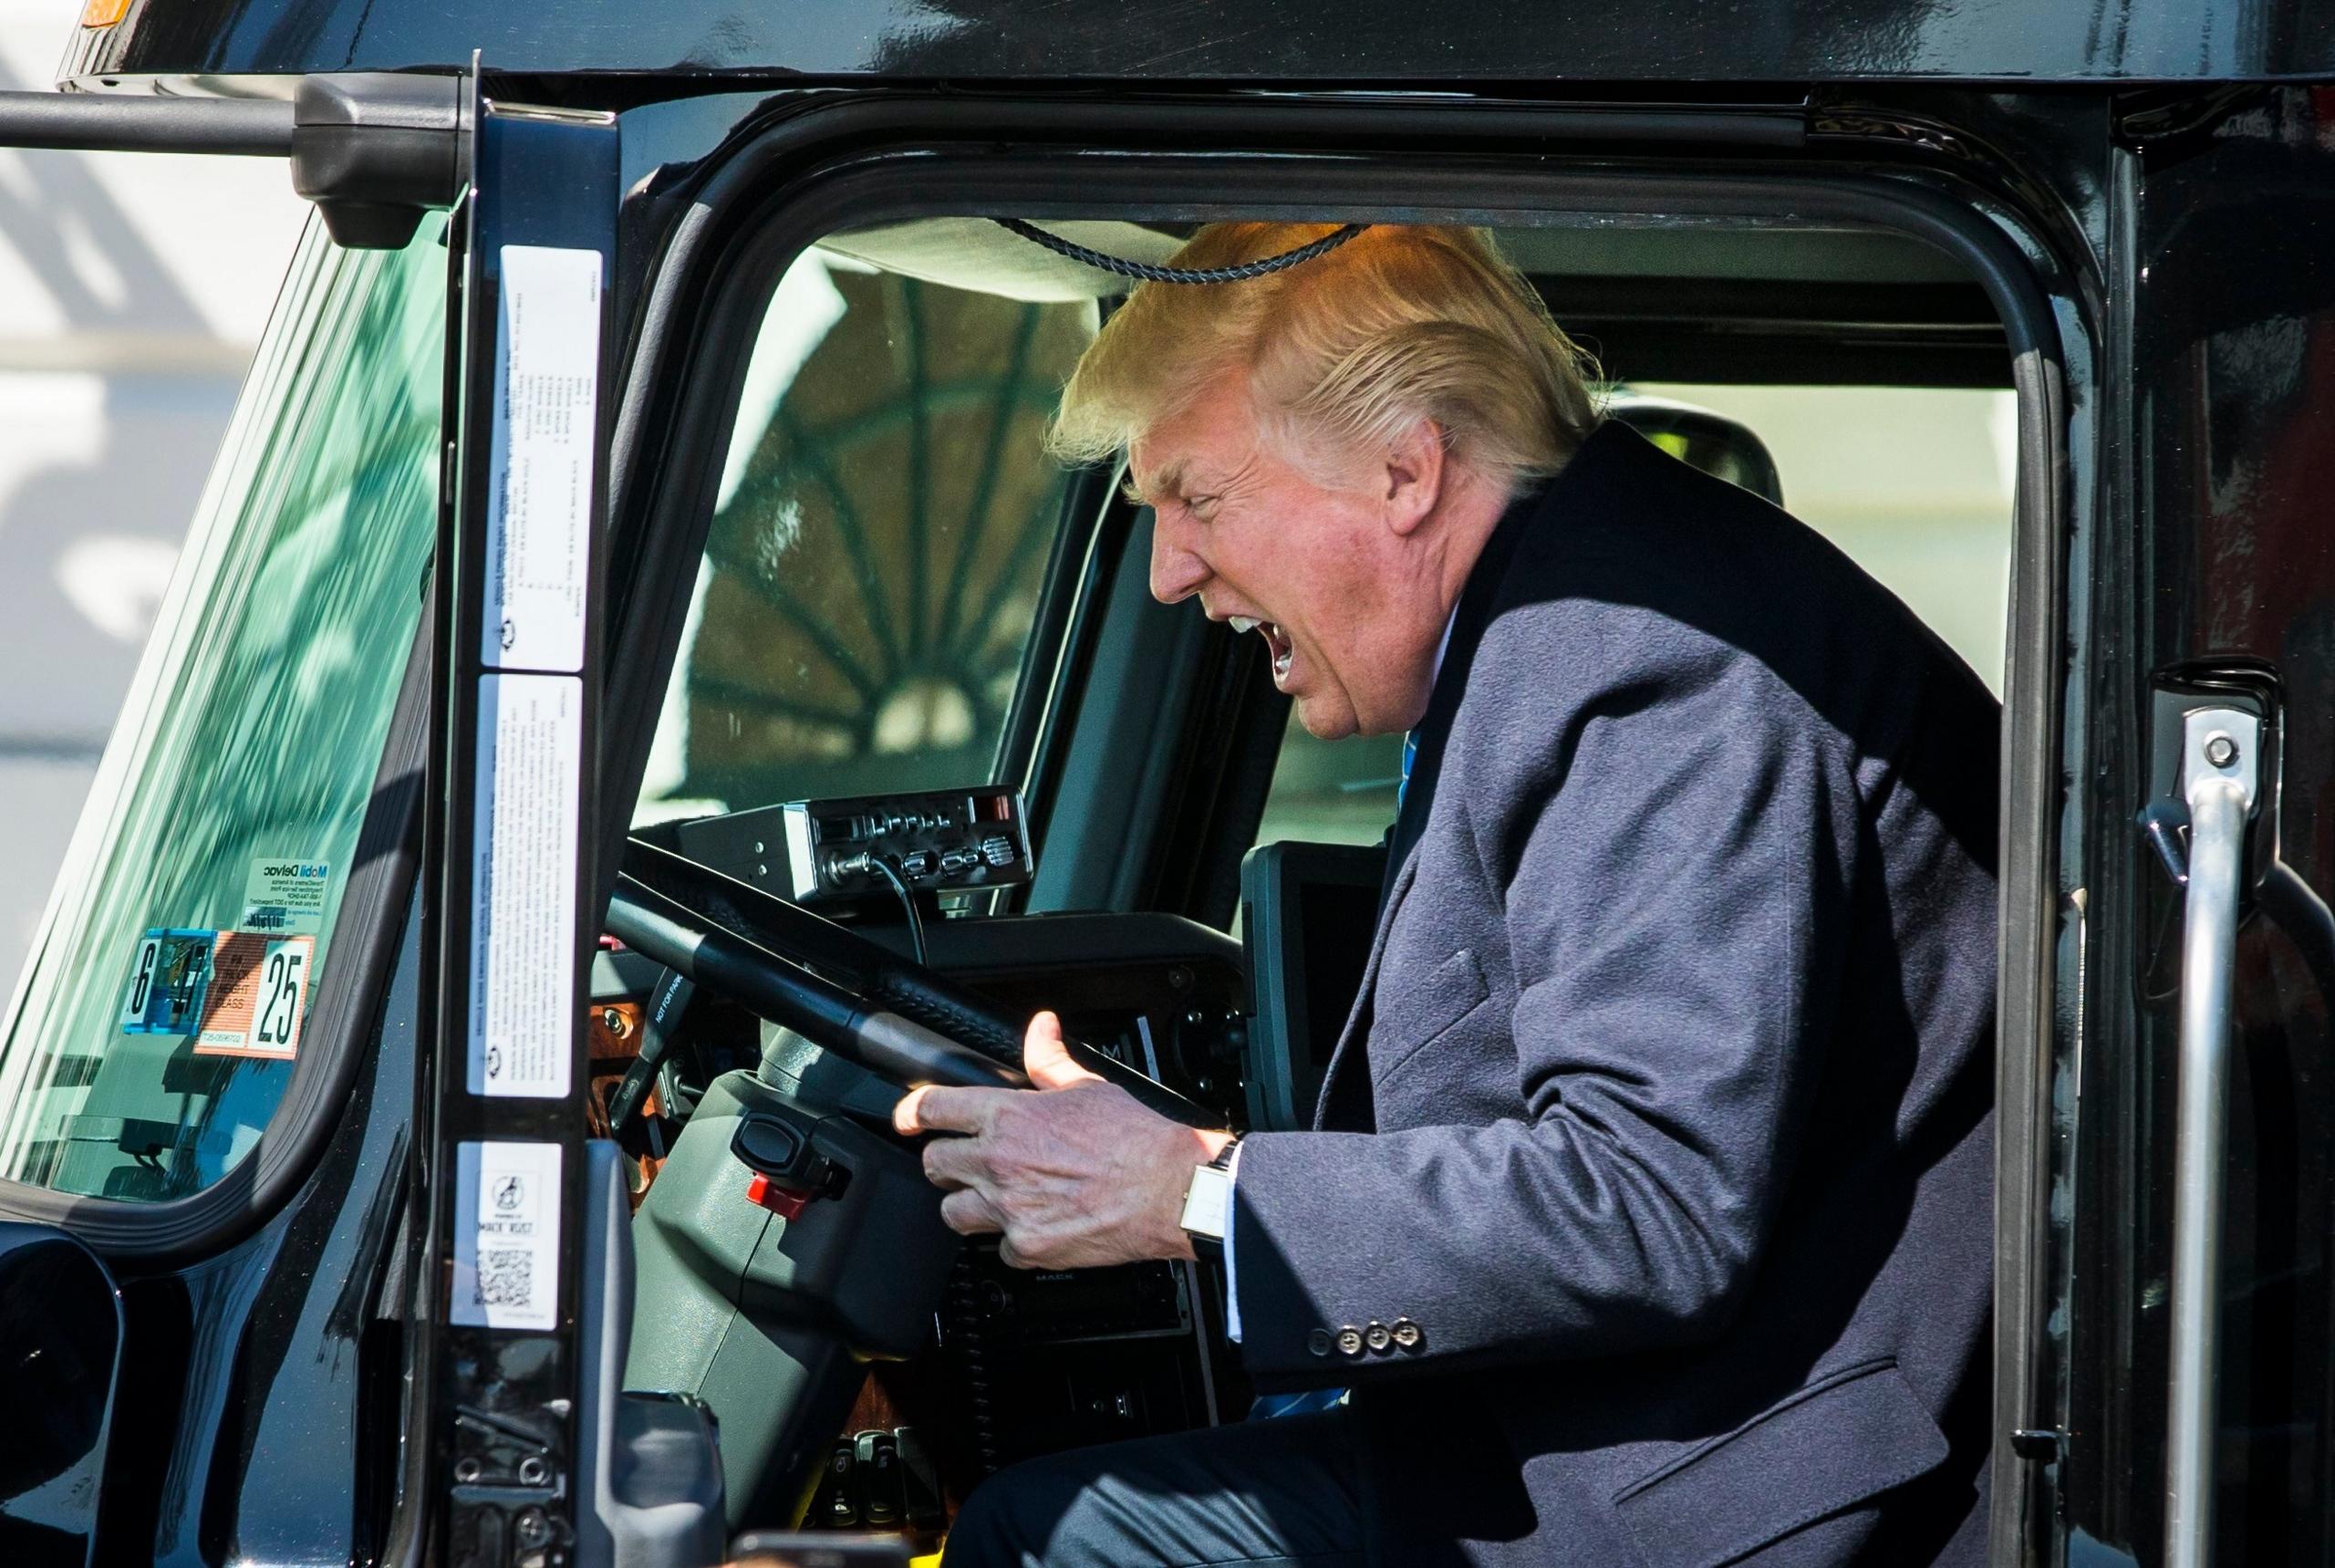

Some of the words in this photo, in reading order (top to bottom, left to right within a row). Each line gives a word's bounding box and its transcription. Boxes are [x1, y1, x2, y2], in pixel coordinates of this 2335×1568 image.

[131, 943, 156, 1014] 6
[215, 998, 244, 1010] CLASS
[257, 953, 302, 1044] 25
[655, 1006, 666, 1023] NOT
[662, 992, 673, 1009] FOR
[1036, 1273, 1074, 1282] MACK
